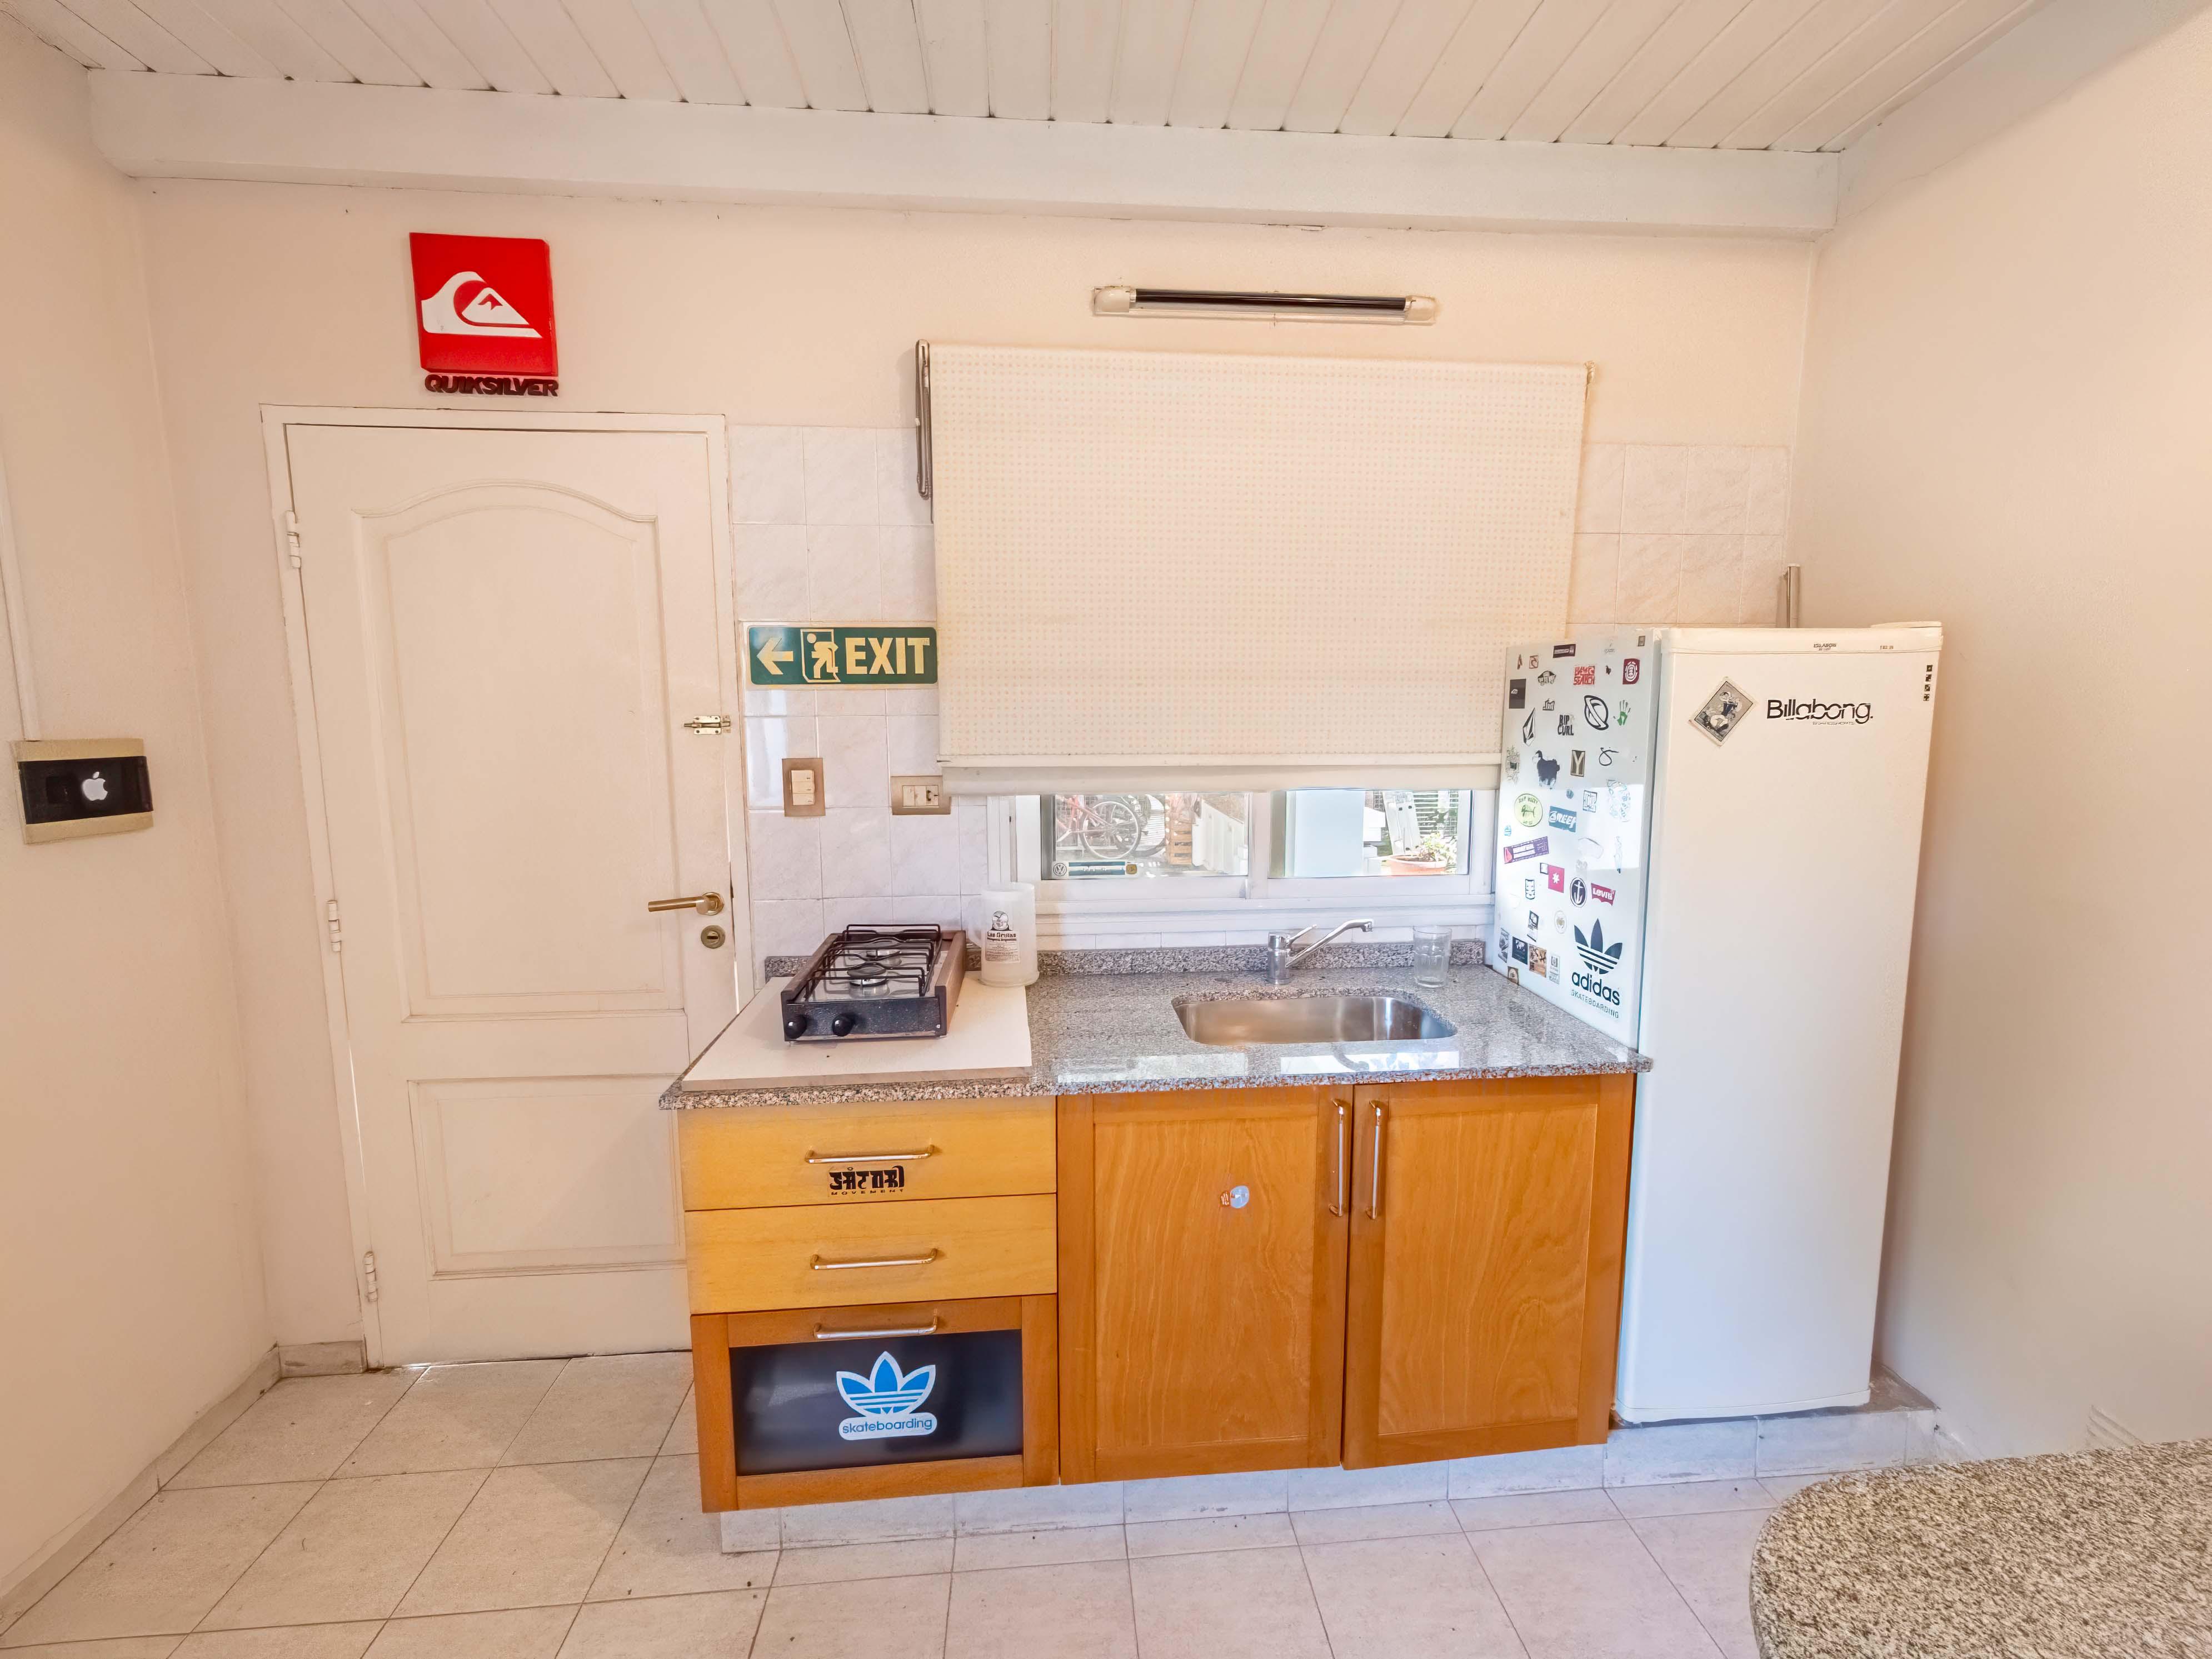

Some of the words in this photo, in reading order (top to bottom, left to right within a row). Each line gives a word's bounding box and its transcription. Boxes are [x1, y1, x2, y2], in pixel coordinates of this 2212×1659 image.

[425, 374, 559, 397] QUIKSILVER
[845, 637, 931, 675] EXIT
[1557, 724, 1574, 736] CURL
[1571, 972, 1620, 1006] adidas
[1571, 989, 1619, 1018] SKATEBOARDING
[842, 1418, 933, 1434] skateboarding
